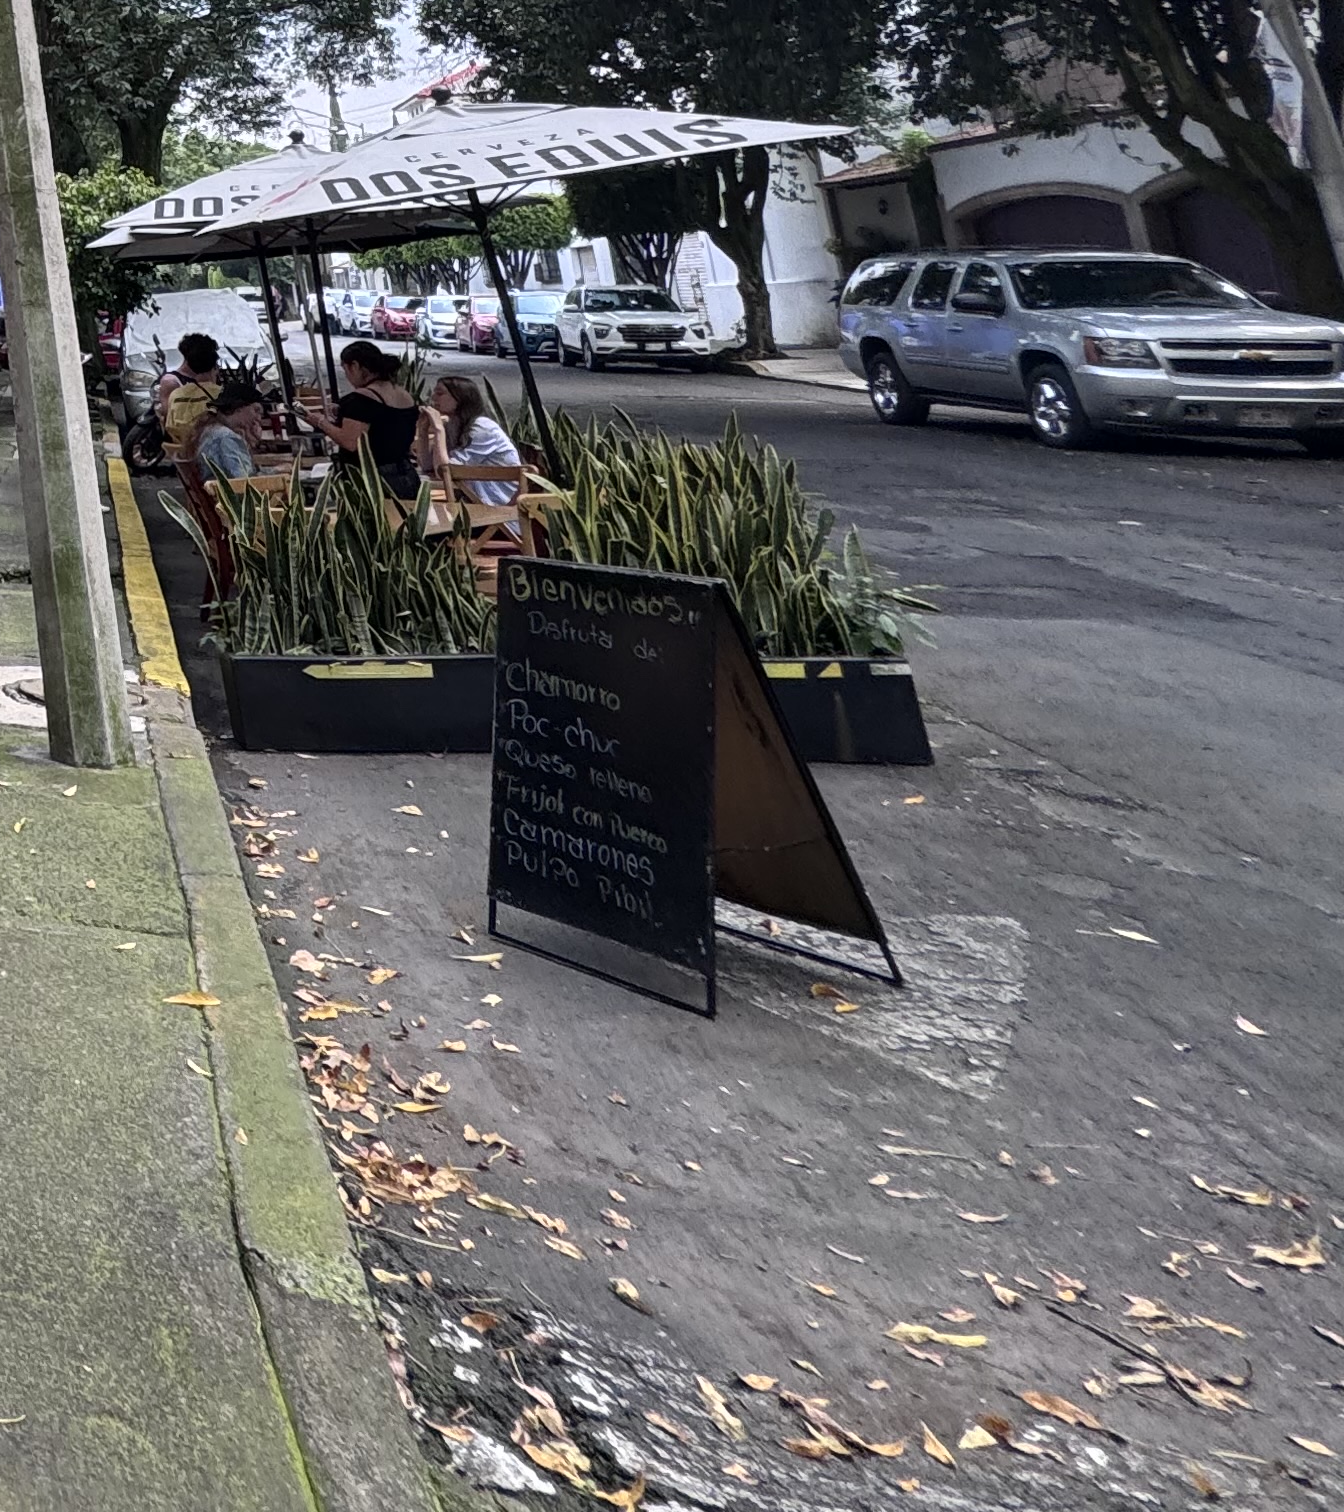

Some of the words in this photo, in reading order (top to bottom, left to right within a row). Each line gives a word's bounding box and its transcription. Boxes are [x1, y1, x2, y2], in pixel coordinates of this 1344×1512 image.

[320, 163, 475, 205] DOS
[484, 118, 749, 178] EQUIS
[403, 127, 597, 163] CERVEZA
[505, 657, 621, 711] Chamorro
[504, 738, 577, 780] Queso
[589, 766, 653, 804] relleno
[505, 774, 564, 815] Frijol
[572, 805, 604, 830] con
[503, 807, 655, 887] Camarones
[504, 840, 580, 888] Pulpo
